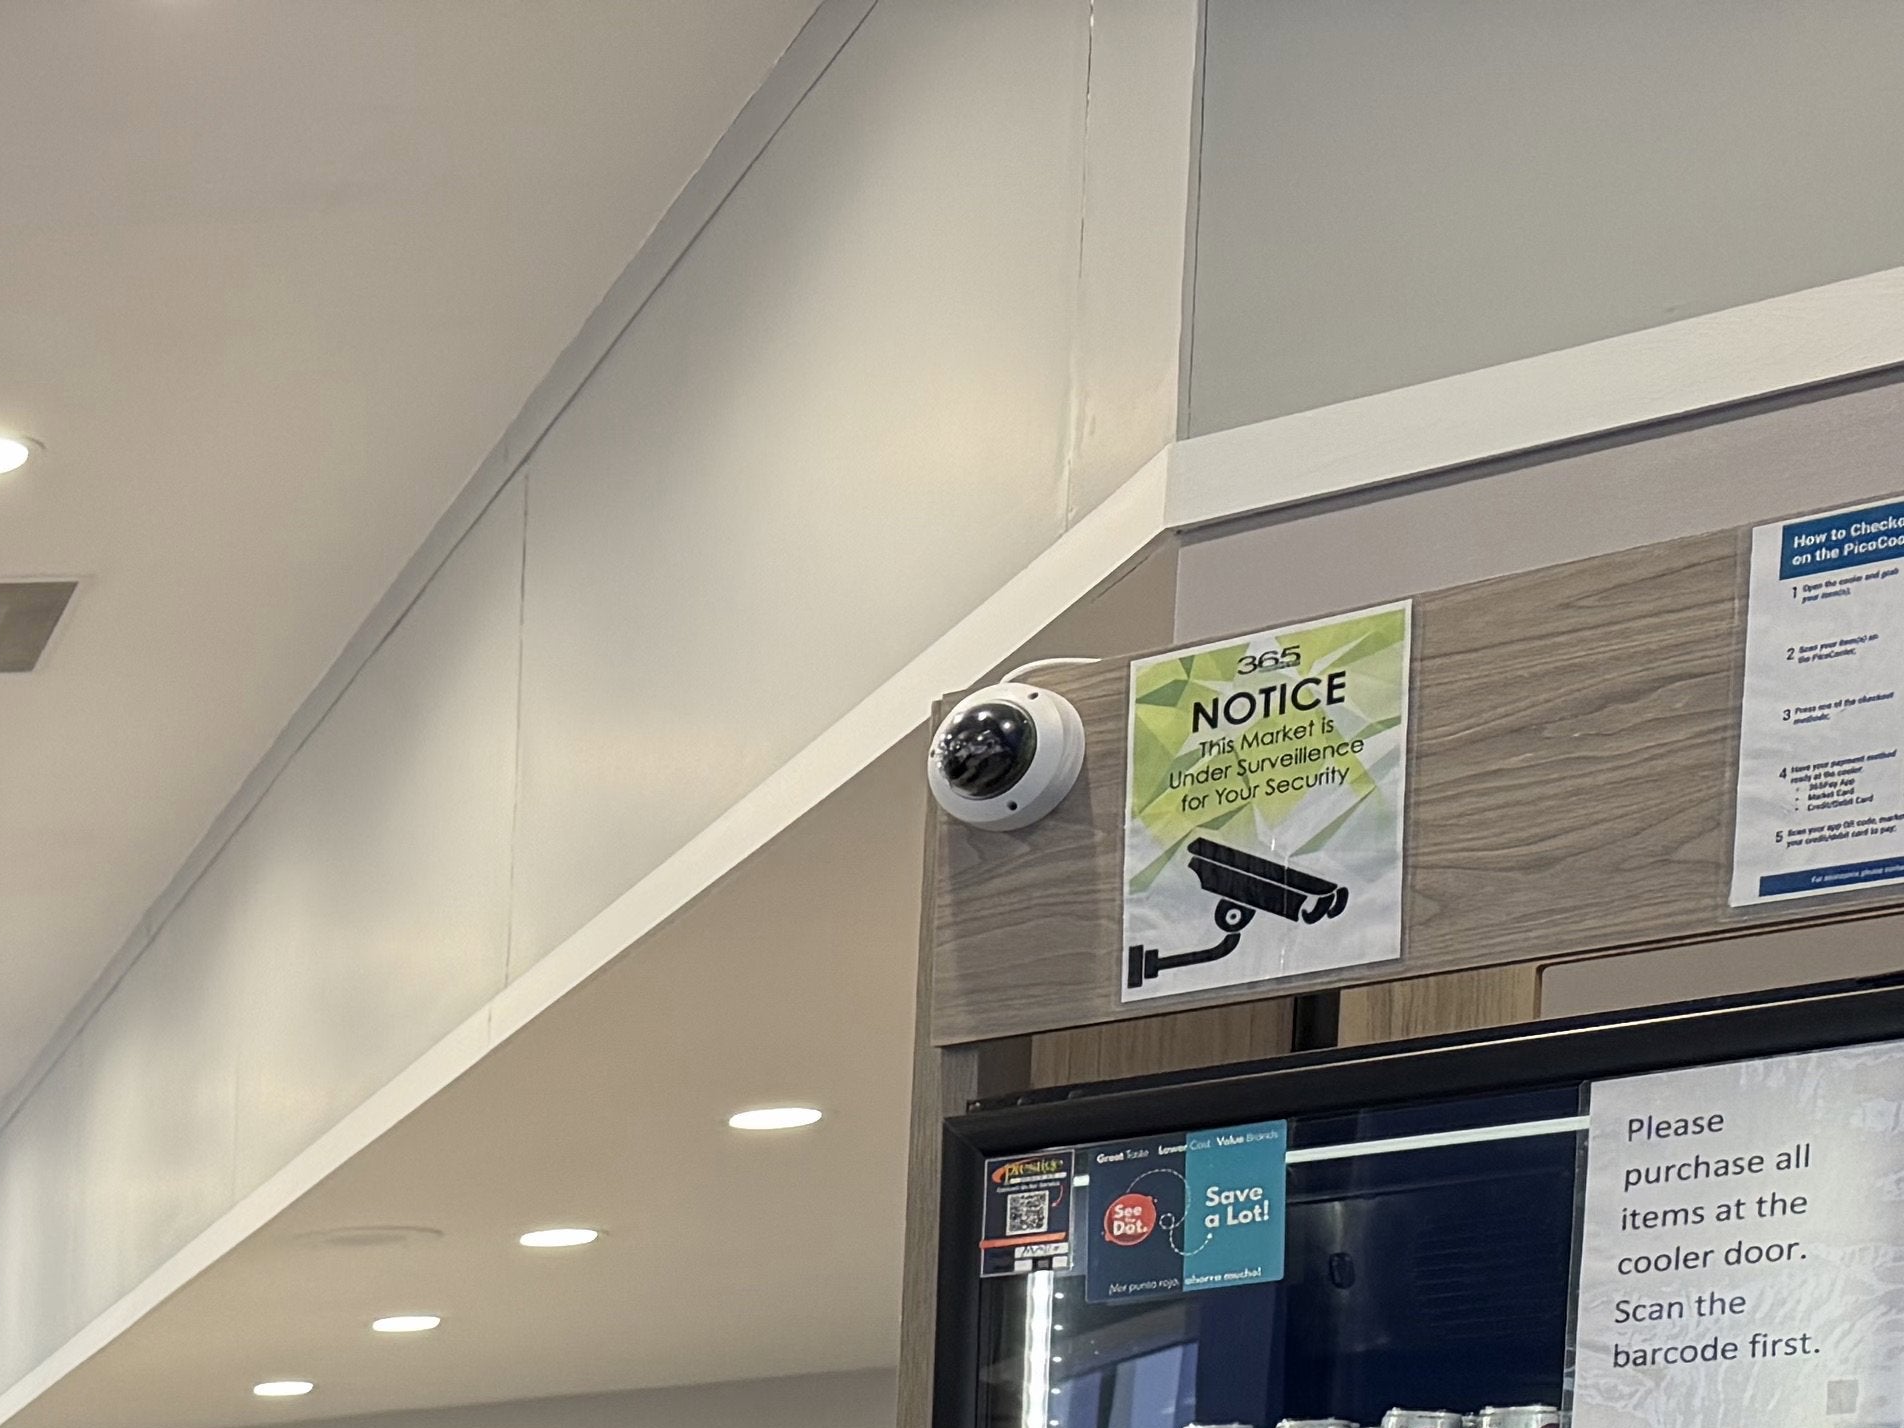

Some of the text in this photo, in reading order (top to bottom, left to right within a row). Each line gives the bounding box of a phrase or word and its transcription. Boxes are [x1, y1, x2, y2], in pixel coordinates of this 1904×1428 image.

[1794, 533, 1827, 549] How
[1831, 529, 1846, 540] to
[1792, 553, 1811, 565] on
[1815, 547, 1839, 561] the
[1793, 586, 1798, 599] 1
[1237, 645, 1301, 675] 365
[1786, 648, 1795, 661] 2
[1192, 671, 1346, 733] NOTICE
[1783, 709, 1791, 721] 3
[1199, 716, 1334, 758] This Market is
[1169, 739, 1364, 790] Under Surveillence
[1779, 767, 1787, 779] 4
[1181, 767, 1349, 812] for Your Security
[1776, 830, 1783, 843] 5
[1628, 1113, 1724, 1142] Please
[1096, 1152, 1124, 1164] Great
[1158, 1144, 1187, 1156] Lower
[1216, 1135, 1244, 1147] Value
[1624, 1143, 1810, 1192] purchase all
[1205, 1184, 1264, 1207] Save
[1114, 1205, 1142, 1218] See
[1205, 1199, 1270, 1228] a Lot!
[1621, 1192, 1808, 1231] items at the
[1113, 1219, 1149, 1236] Dot.
[1618, 1240, 1807, 1275] cooler door.
[1614, 1291, 1746, 1323] Scan the
[1613, 1333, 1820, 1368] barcode first.
